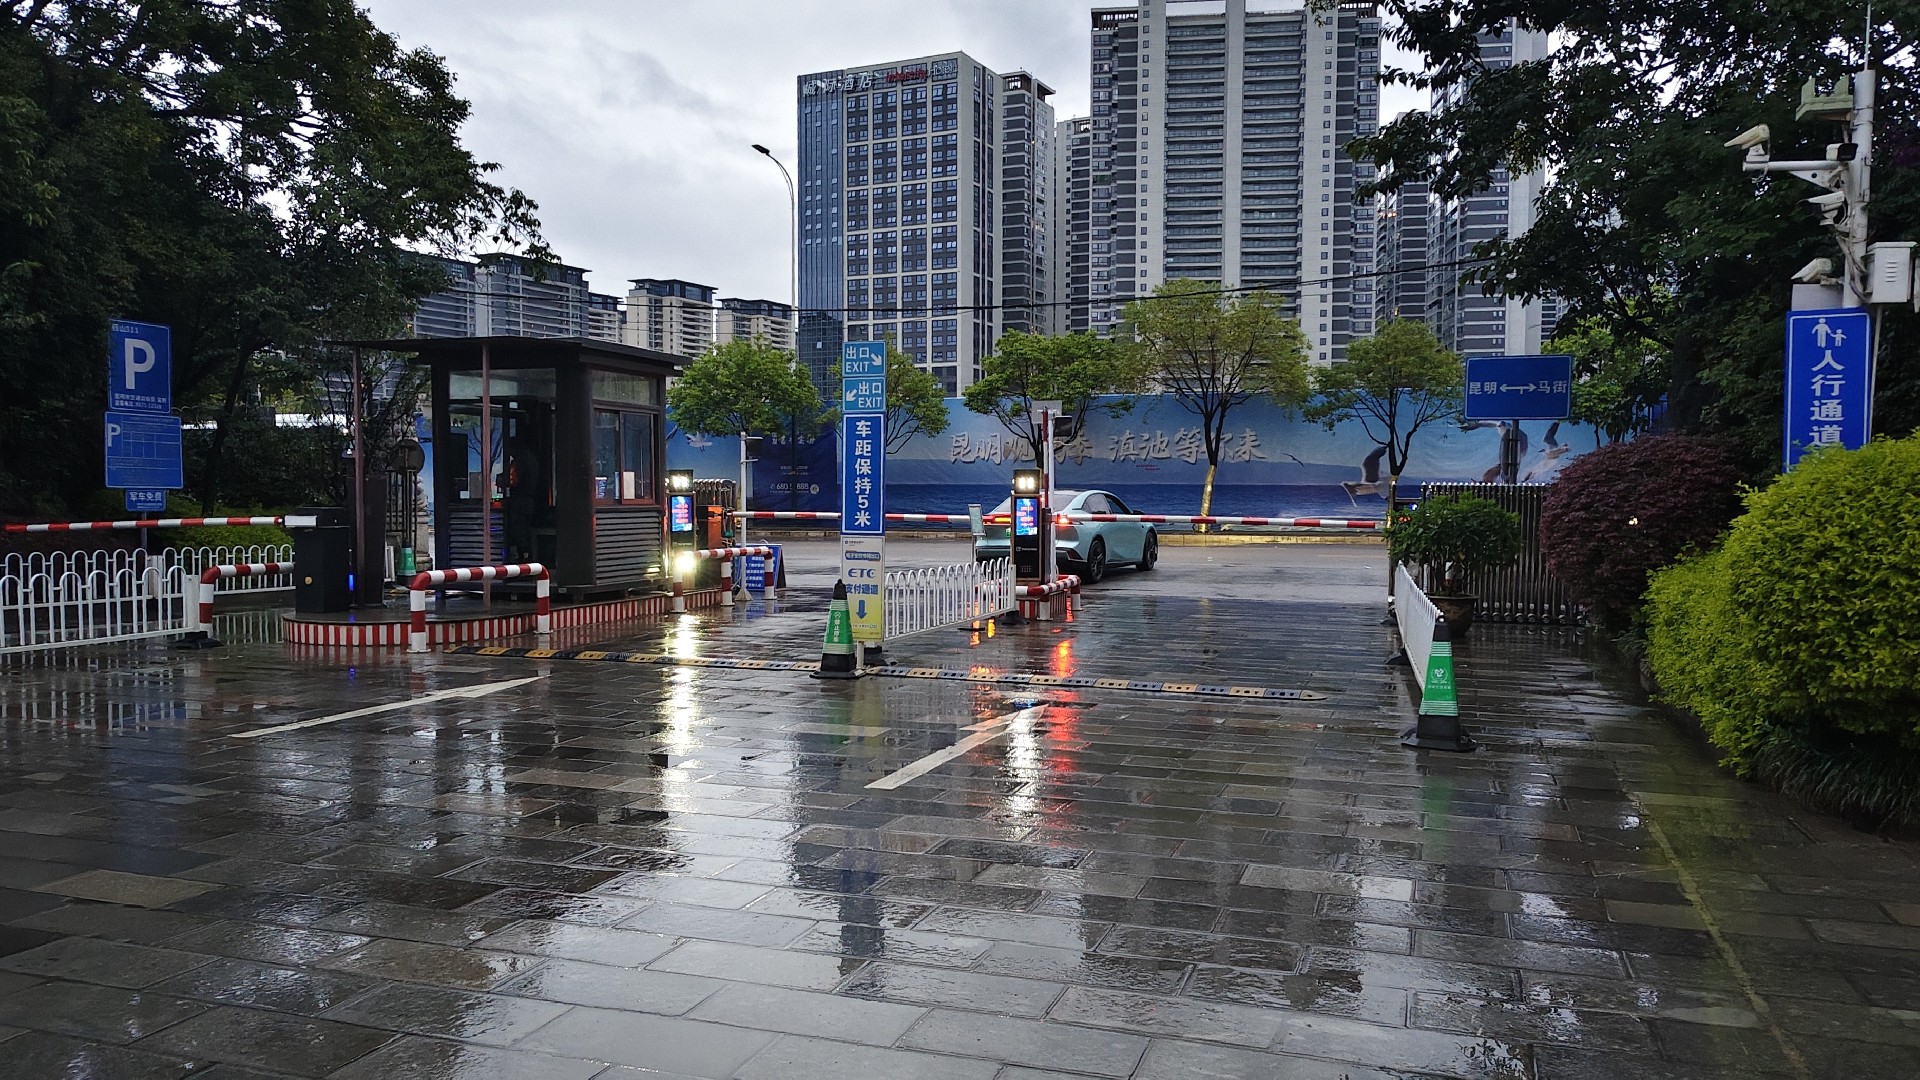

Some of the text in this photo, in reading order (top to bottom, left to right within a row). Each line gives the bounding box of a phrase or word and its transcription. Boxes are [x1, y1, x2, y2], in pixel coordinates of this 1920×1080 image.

[846, 346, 869, 359] 出口
[125, 337, 155, 389] P
[846, 361, 869, 372] EXIT
[858, 381, 881, 394] 出口
[1469, 380, 1567, 394] 昆明 马街
[858, 397, 882, 408] EXIT
[1809, 350, 1846, 447] 人行通道
[107, 423, 120, 447] P
[854, 420, 872, 527] 车距保持5米
[848, 568, 876, 578] ETC
[846, 583, 879, 595] 支付通道
